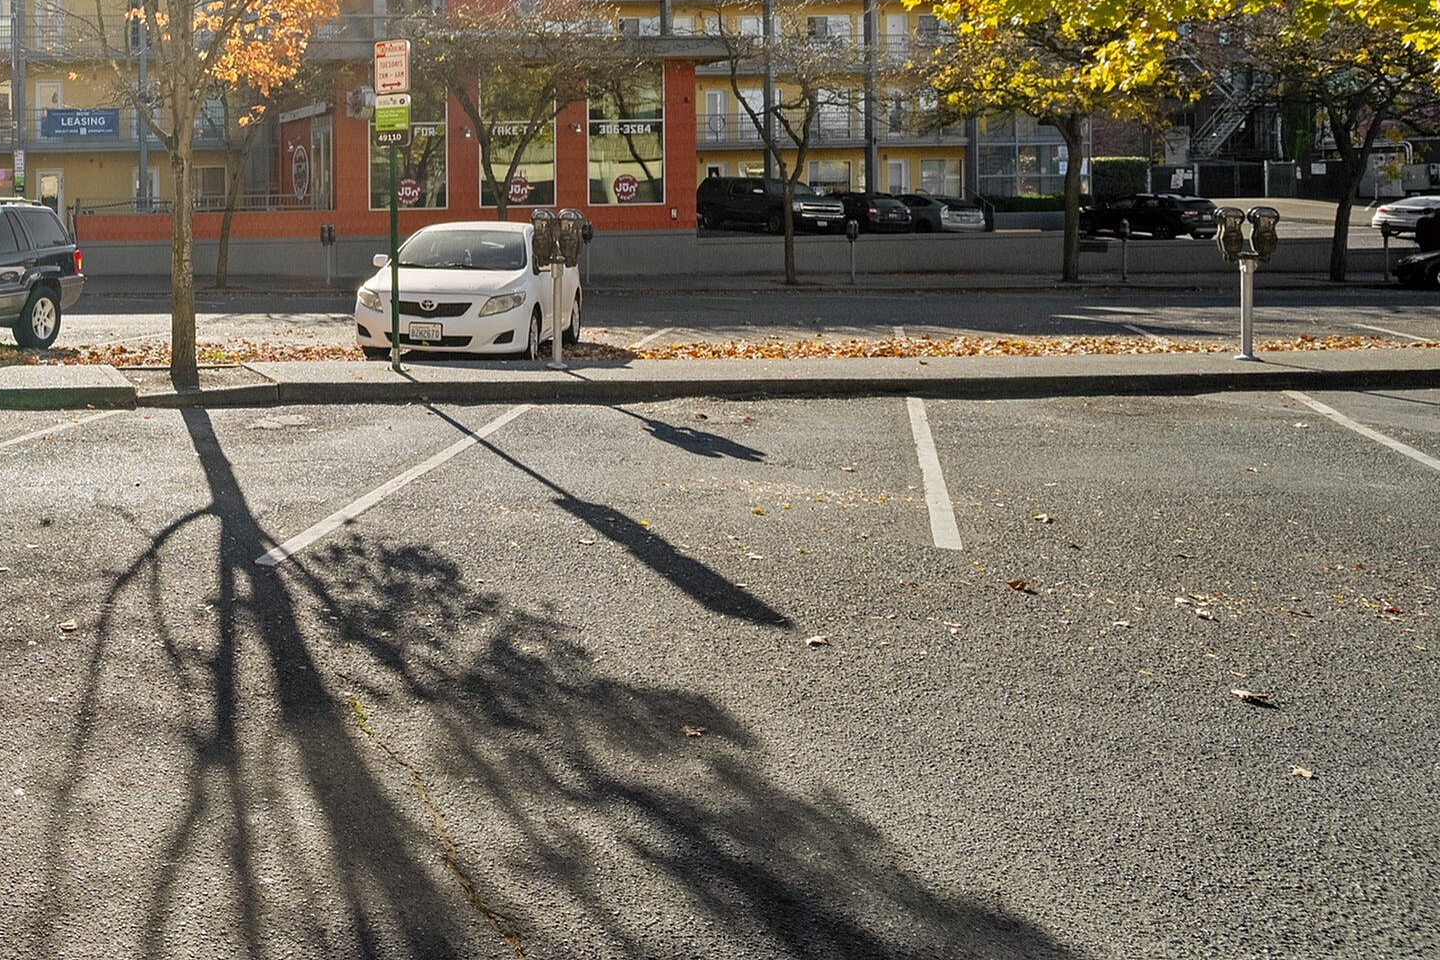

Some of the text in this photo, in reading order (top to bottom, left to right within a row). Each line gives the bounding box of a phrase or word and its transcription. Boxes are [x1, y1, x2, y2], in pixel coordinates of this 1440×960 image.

[61, 117, 106, 126] LEASING
[414, 126, 435, 138] FOR
[491, 125, 545, 136] TAKE-
[378, 133, 402, 142] 49110
